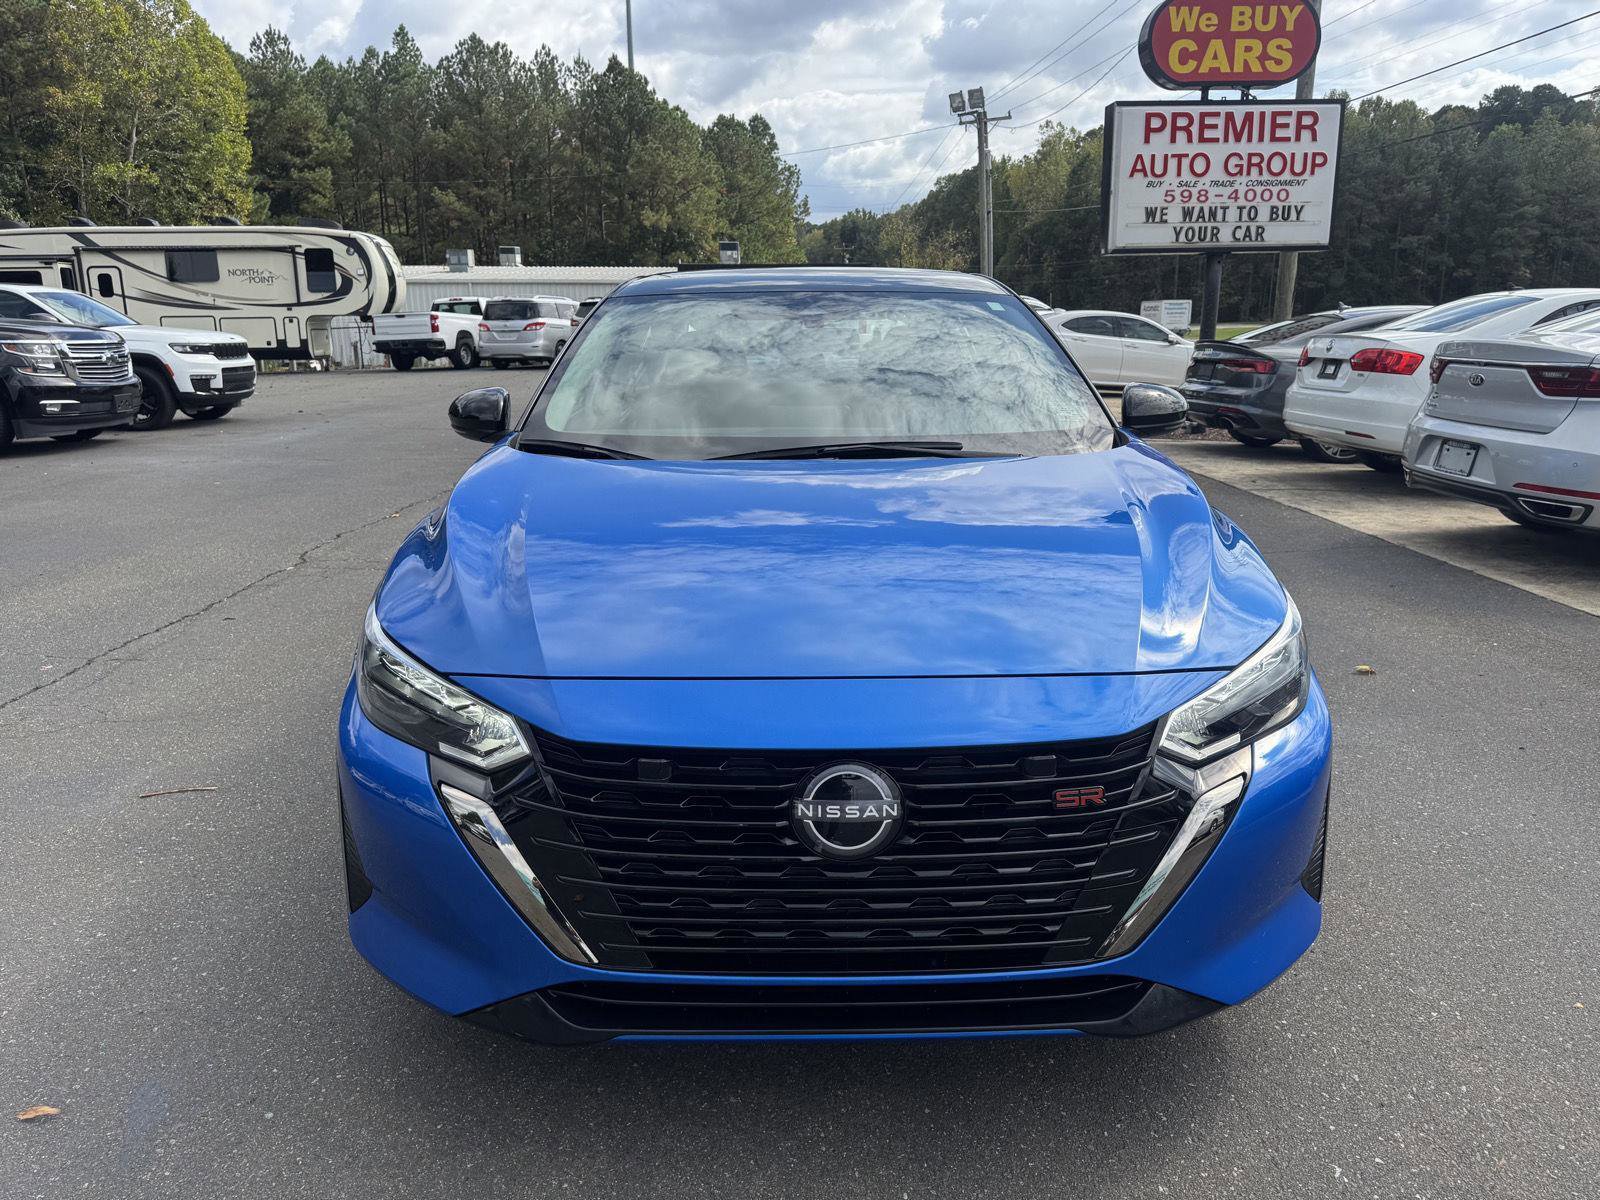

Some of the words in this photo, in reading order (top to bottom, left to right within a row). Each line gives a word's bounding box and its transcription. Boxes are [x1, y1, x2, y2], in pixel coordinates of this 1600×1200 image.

[1168, 6, 1219, 32] We
[1230, 5, 1304, 32] BUY
[1168, 38, 1293, 74] CARS
[1143, 111, 1320, 144] PREMIER
[1128, 153, 1211, 178] AUTO
[1223, 151, 1328, 177] GROUP
[1145, 180, 1165, 188] BUY
[1176, 180, 1199, 188] SALE
[1208, 180, 1237, 188] TRADE
[1245, 179, 1308, 187] CONSIGNMENT
[1163, 188, 1290, 203] 598-4000
[1144, 206, 1169, 223] WE
[1181, 206, 1229, 223] WANT
[1236, 205, 1259, 221] TO
[1268, 205, 1305, 221] BUY
[1173, 226, 1220, 243] YOUR
[1231, 225, 1266, 242] CAR
[227, 269, 260, 277] NORTH
[248, 276, 275, 284] POINT
[1054, 786, 1106, 809] SR
[798, 803, 898, 818] NISSAN
